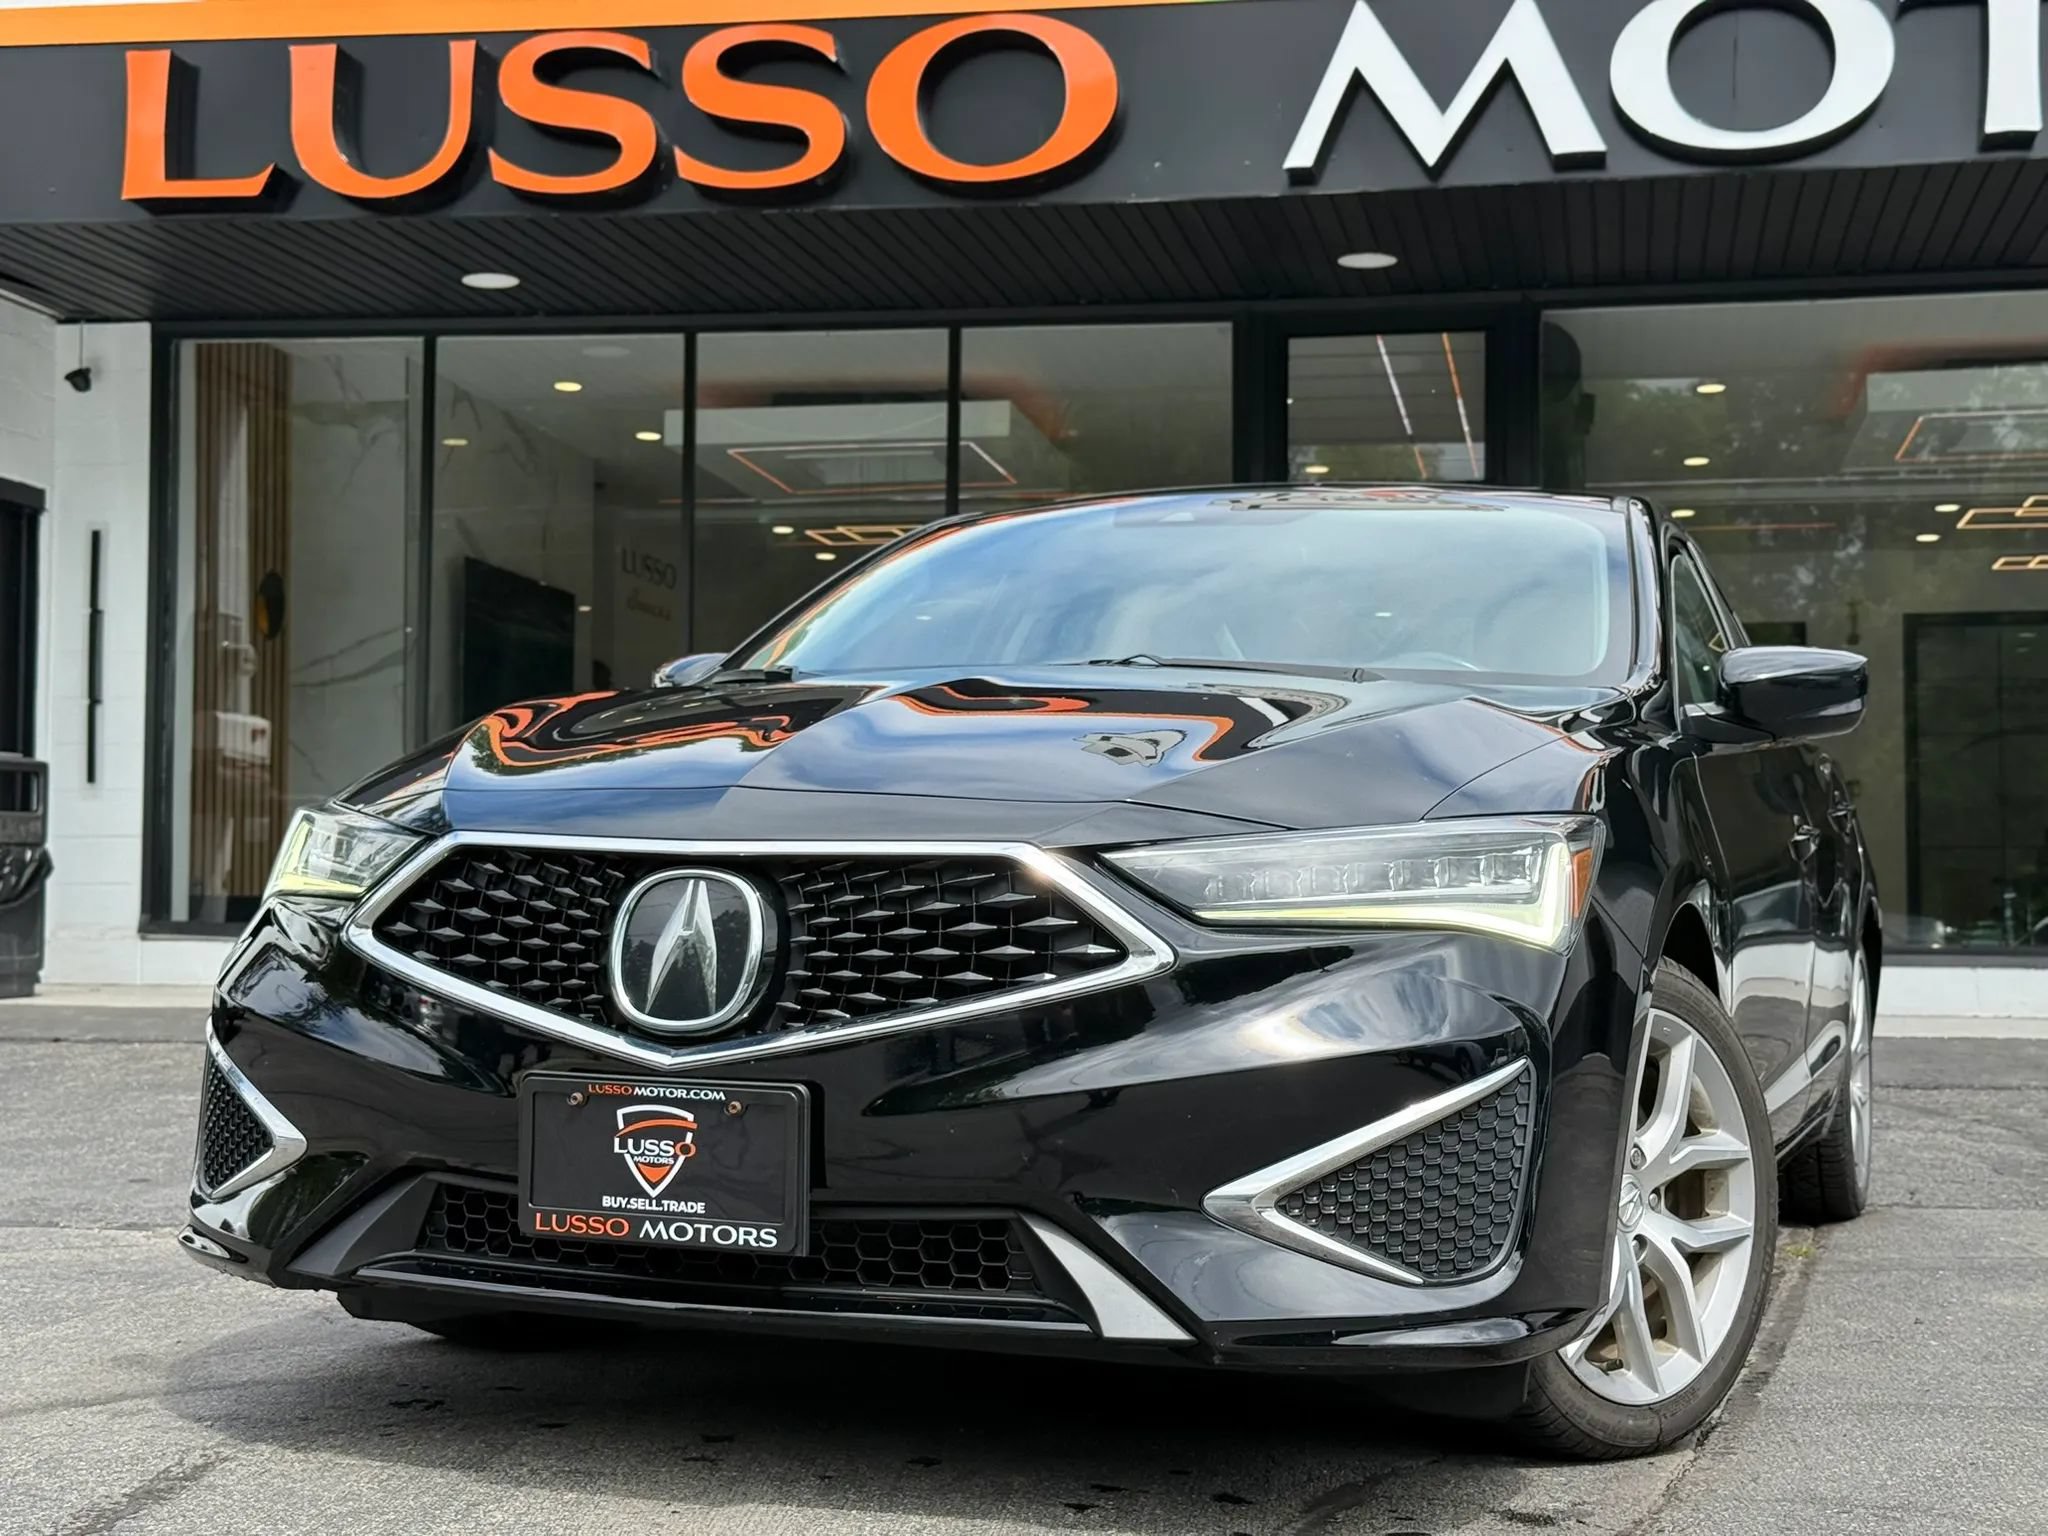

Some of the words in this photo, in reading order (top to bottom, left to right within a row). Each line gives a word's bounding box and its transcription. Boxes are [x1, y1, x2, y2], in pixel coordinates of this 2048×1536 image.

[121, 12, 1119, 200] LUSSO
[613, 1136, 697, 1158] LUSSO
[632, 1155, 675, 1165] MOTORS
[602, 1195, 706, 1214] BUY.SELL.TRADE
[535, 1212, 630, 1237] LUSSO
[639, 1219, 778, 1248] MOTORS
